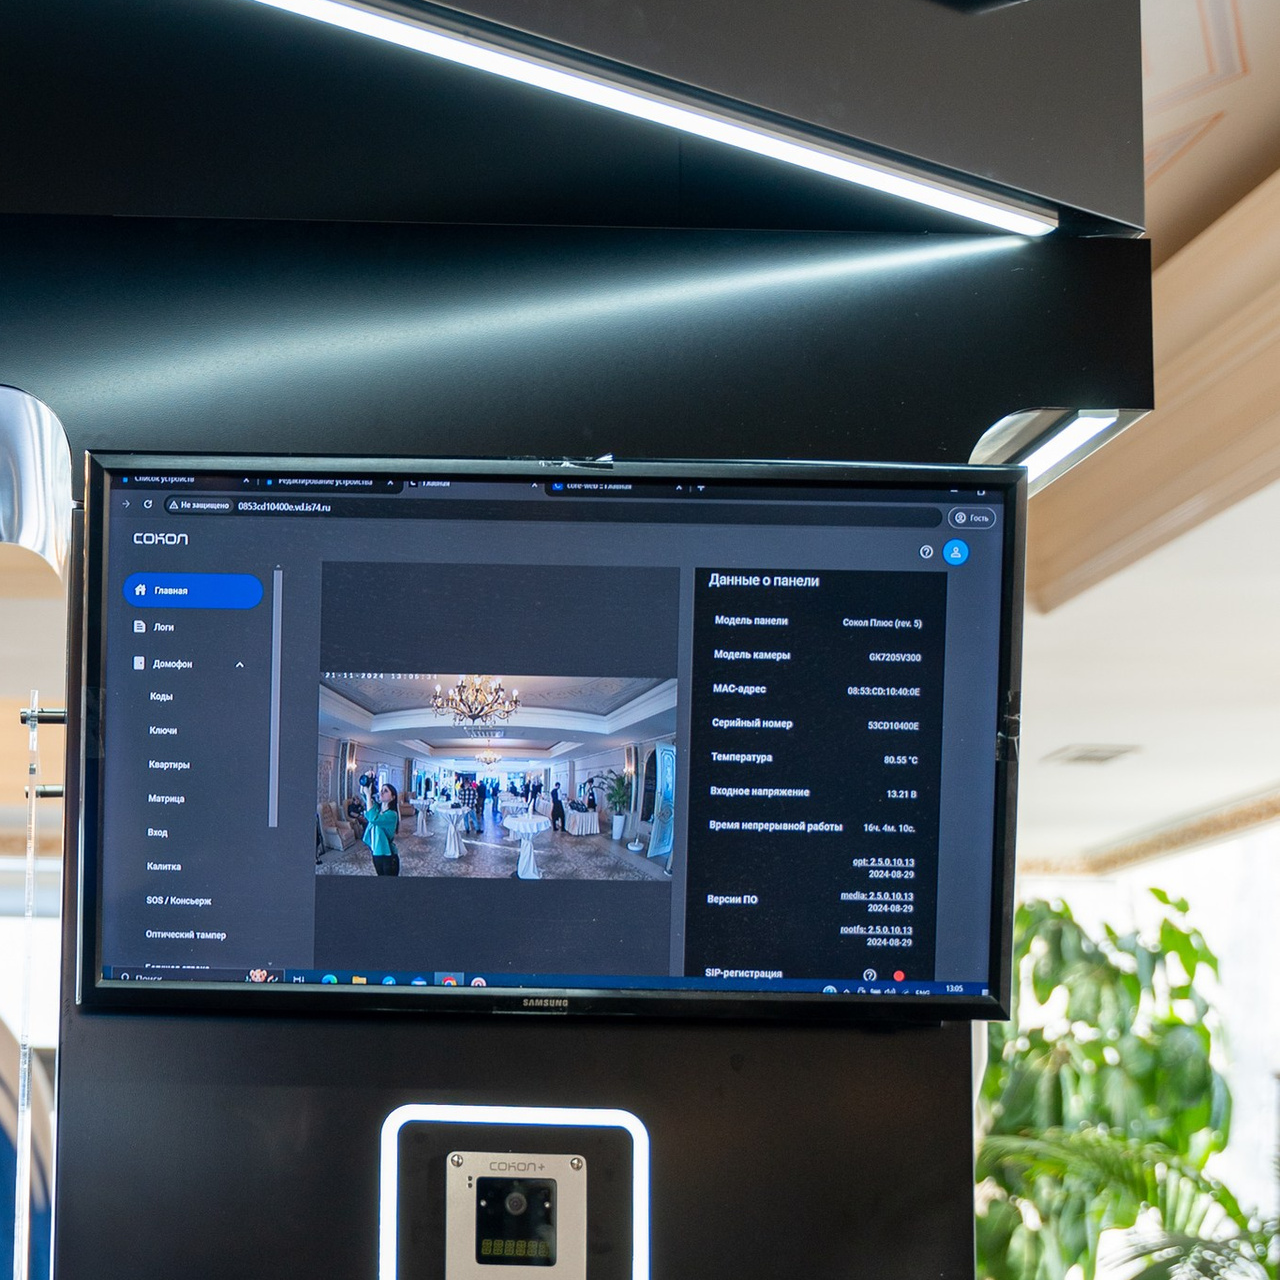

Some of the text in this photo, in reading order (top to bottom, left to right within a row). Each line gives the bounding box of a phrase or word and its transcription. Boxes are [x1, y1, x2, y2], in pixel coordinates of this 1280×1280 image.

[192, 502, 229, 510] защищено
[709, 573, 819, 587] Данные о панели
[155, 587, 188, 595] Главная
[715, 615, 788, 626] Модель панели
[843, 619, 922, 629] Сокол Плюс (rev. 5)
[154, 623, 174, 632] Логи
[714, 650, 790, 661] Модель камеры
[869, 653, 921, 662] GK7205V300
[153, 660, 192, 670] Домофон
[150, 692, 173, 701] Коды
[712, 718, 793, 729] Серийный номер
[868, 721, 919, 730] 53CD10400E
[150, 726, 177, 735] Ключи
[712, 752, 772, 763] Температура
[884, 755, 907, 764] 80.55
[149, 760, 190, 770] Квартиры
[710, 787, 810, 798] Входное напряжение
[887, 789, 908, 798] 13.21
[148, 794, 185, 804] Матрица
[710, 820, 842, 833] Время непрерывной работы
[864, 823, 916, 833] 16ч. 4м. 10с.
[148, 829, 168, 838] Вход
[147, 862, 181, 871] Калитка
[853, 858, 914, 867] opt: 2.5.0.10.13
[869, 871, 914, 879] 2024-08-29
[707, 895, 758, 905] Версии ПО
[840, 891, 913, 901] media: 2.5.0.10.13
[147, 896, 163, 905] SOS
[170, 897, 212, 907] Консьерж
[868, 904, 913, 913] 2024-08-29
[840, 925, 912, 935] rootfs: 2.5.0.10.13
[146, 930, 227, 941] Оптический тампер
[867, 938, 912, 947] 2024-08-29
[706, 969, 782, 979] SIP-регистрация
[946, 985, 963, 993] 13:05
[523, 999, 569, 1008] SAMSUNG
